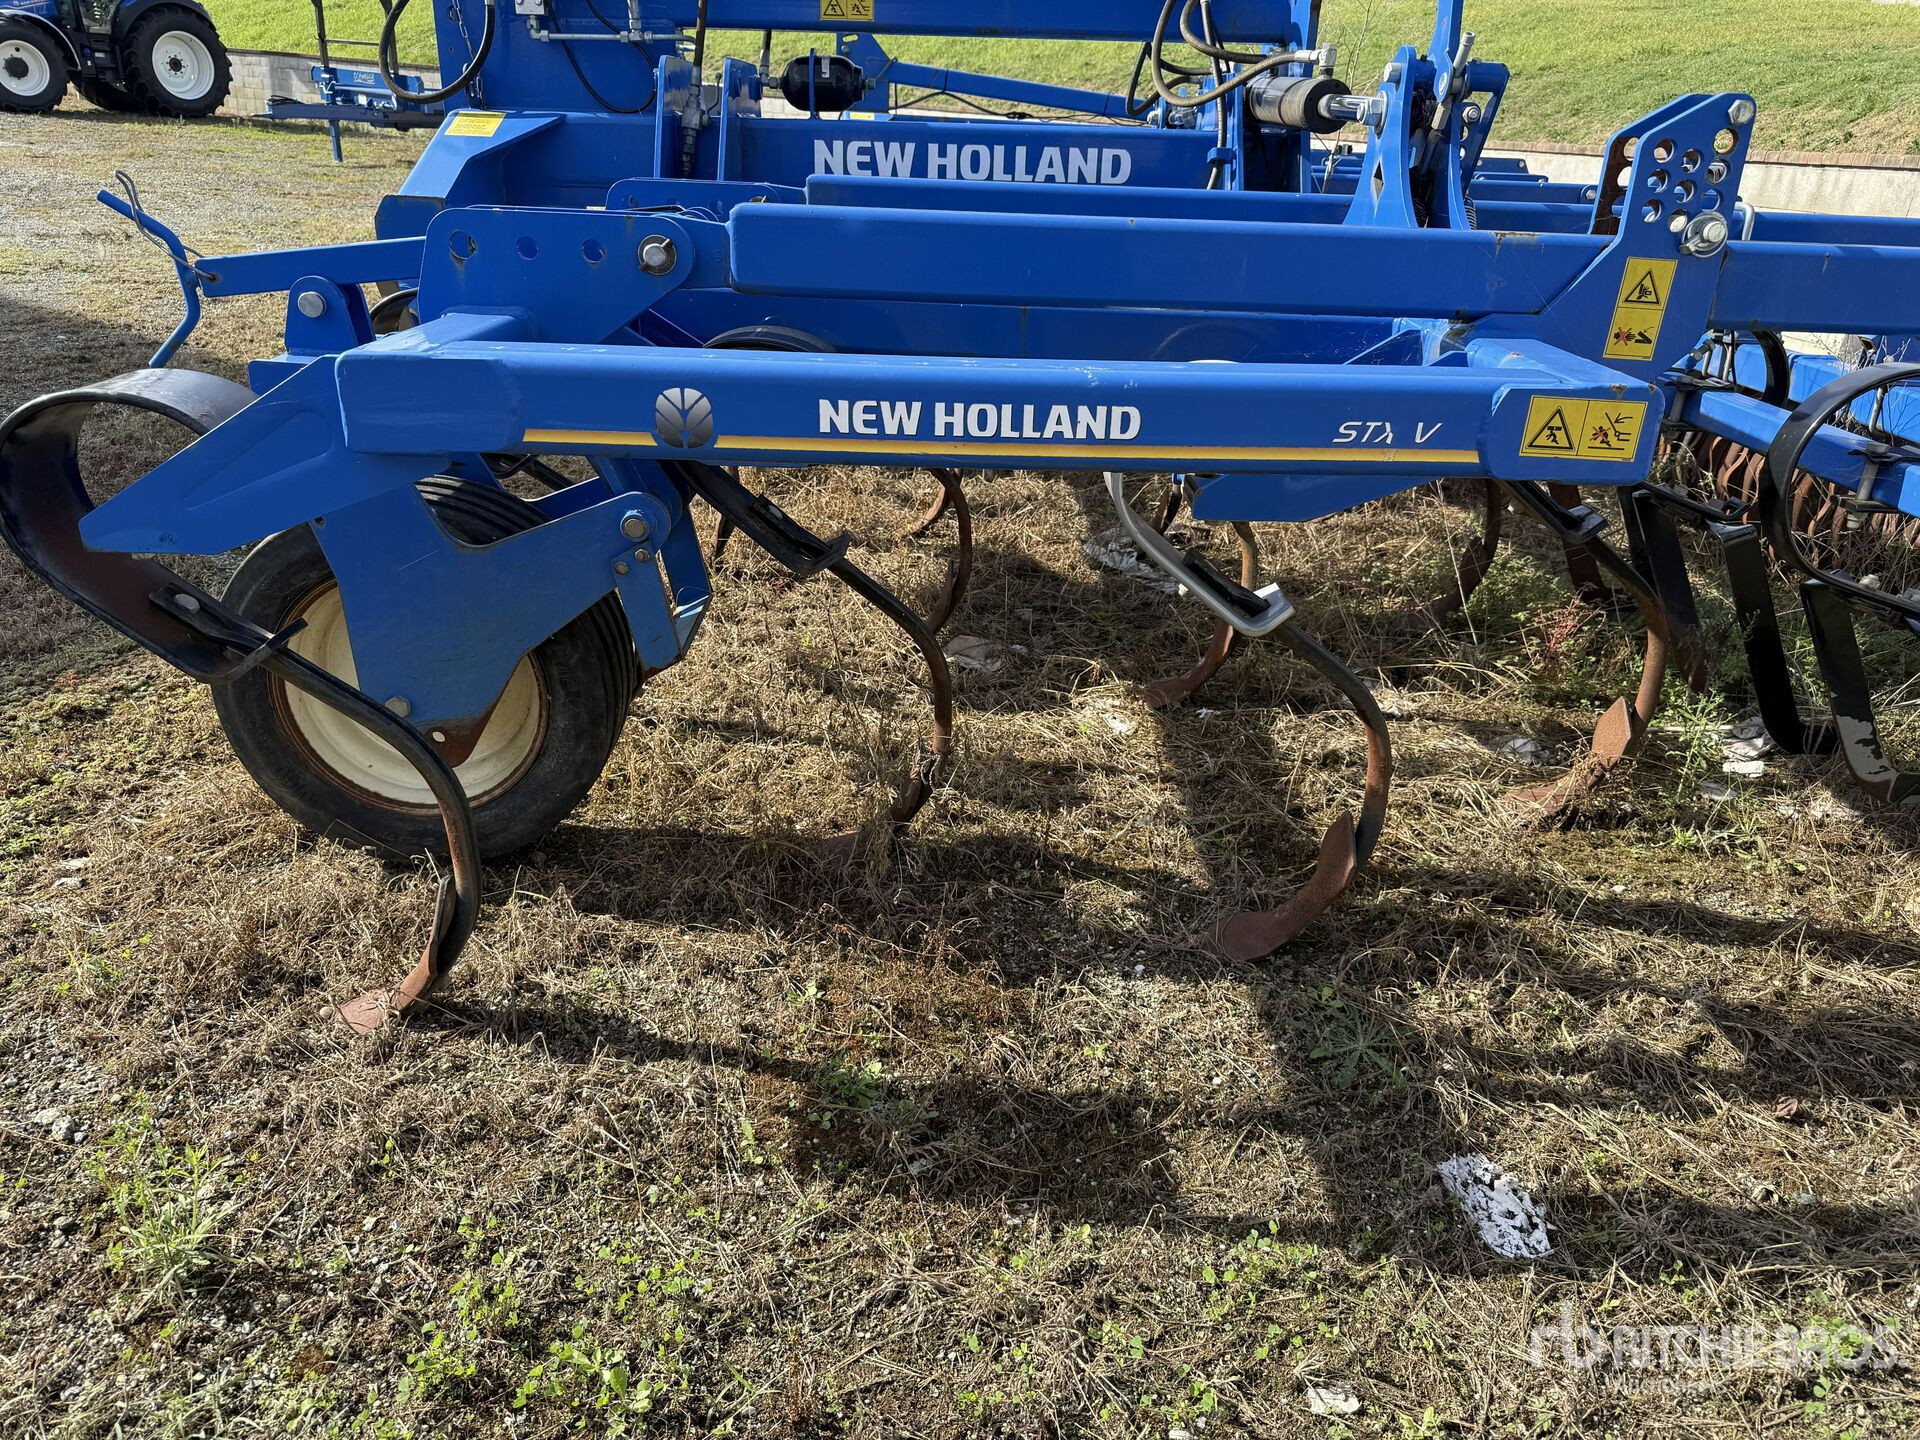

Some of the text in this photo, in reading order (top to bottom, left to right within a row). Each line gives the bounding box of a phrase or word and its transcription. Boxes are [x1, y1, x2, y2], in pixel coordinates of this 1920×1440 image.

[814, 139, 1132, 185] NEW HOLLAND
[819, 399, 1141, 440] NEW HOLLAND
[1414, 422, 1443, 443] V
